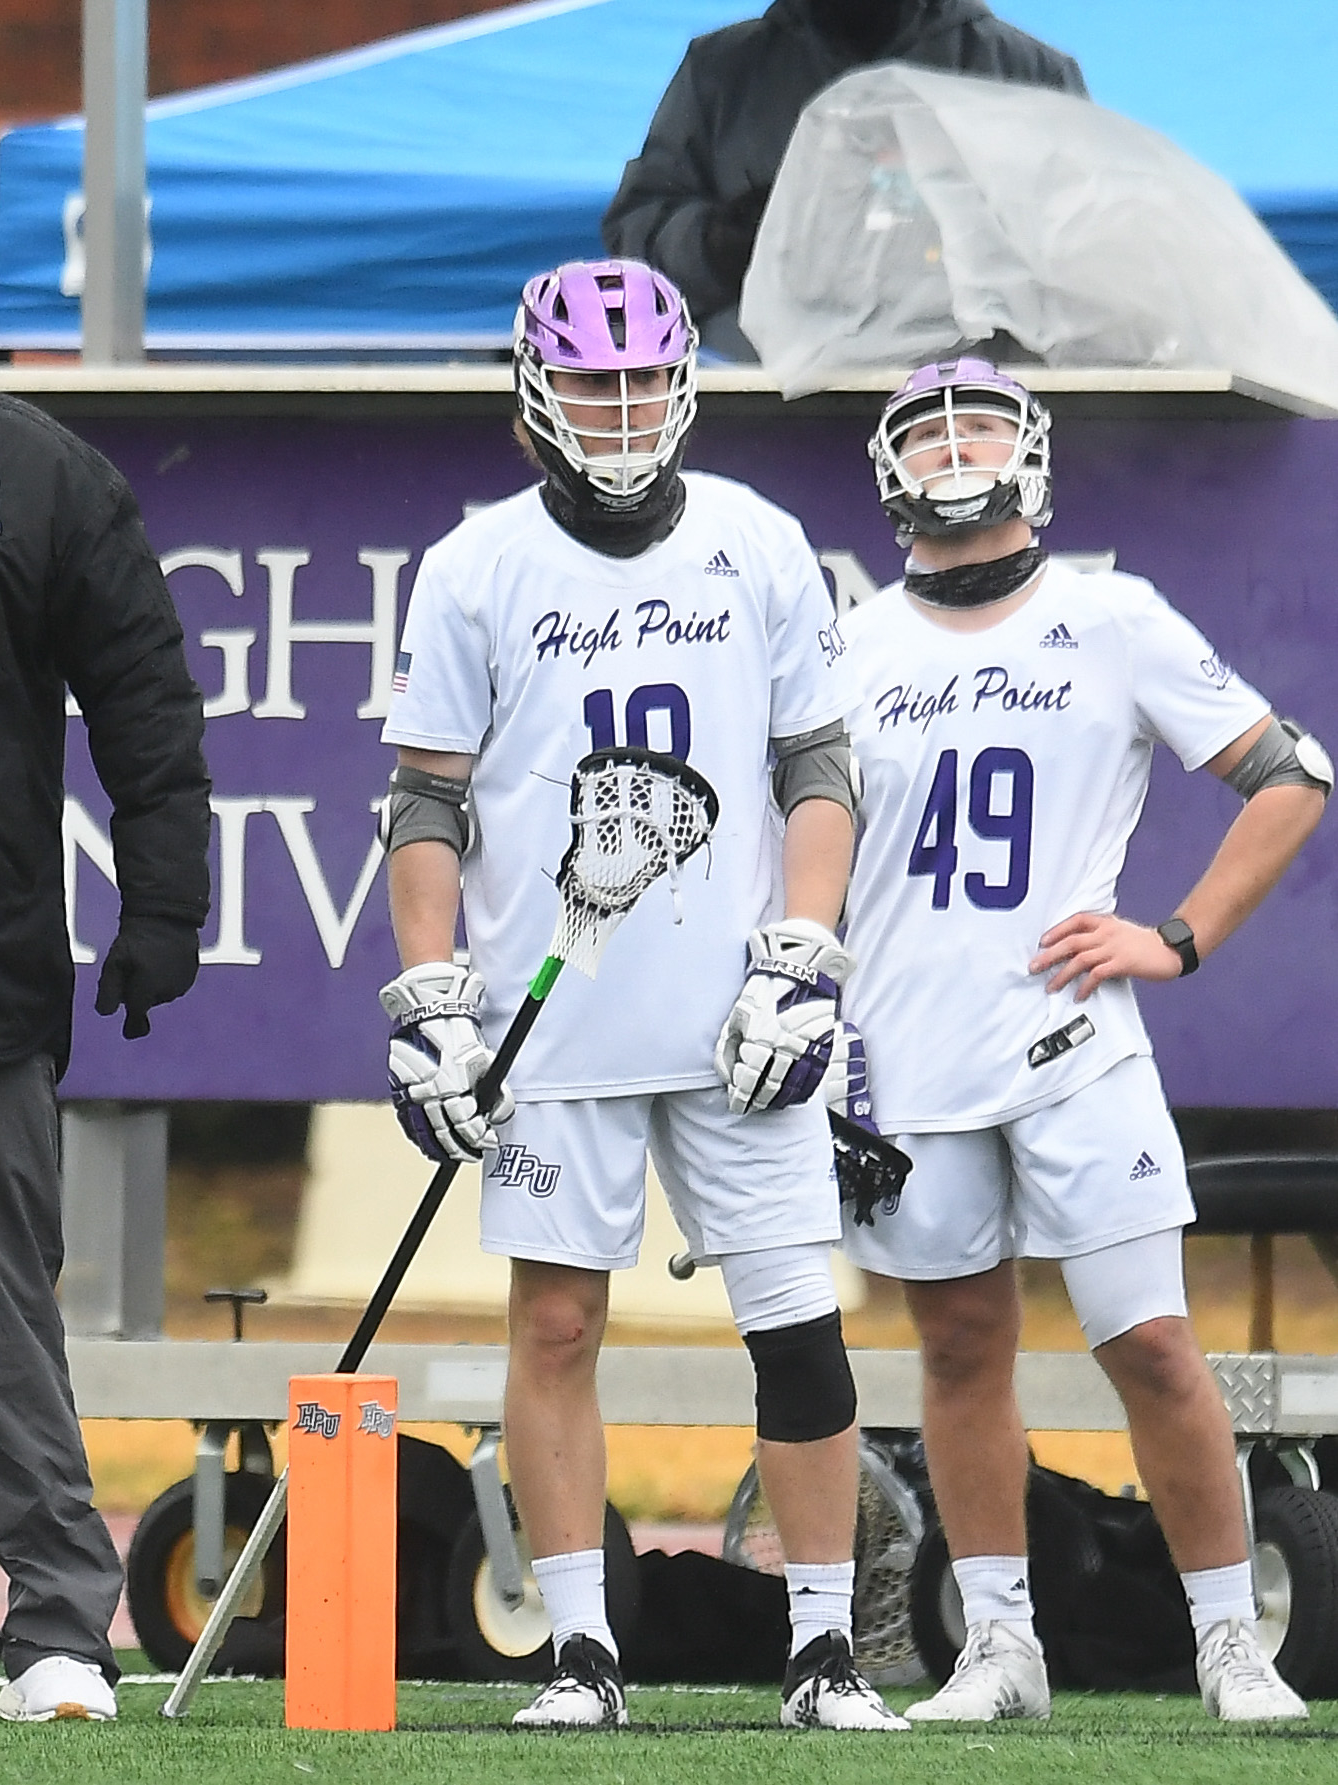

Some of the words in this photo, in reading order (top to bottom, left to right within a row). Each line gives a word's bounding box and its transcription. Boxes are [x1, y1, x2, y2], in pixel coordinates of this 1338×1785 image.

[704, 566, 740, 578] adidas
[64, 547, 412, 720] GH
[531, 608, 623, 670] High
[634, 598, 731, 649] Point
[1039, 638, 1079, 650] adidas
[874, 674, 960, 736] High
[972, 665, 1073, 713] Point
[907, 746, 1035, 913] 49
[487, 1143, 562, 1200] HPU
[1129, 1166, 1162, 1182] adidas
[292, 1401, 342, 1440] HPU
[356, 1400, 396, 1440] HPU
